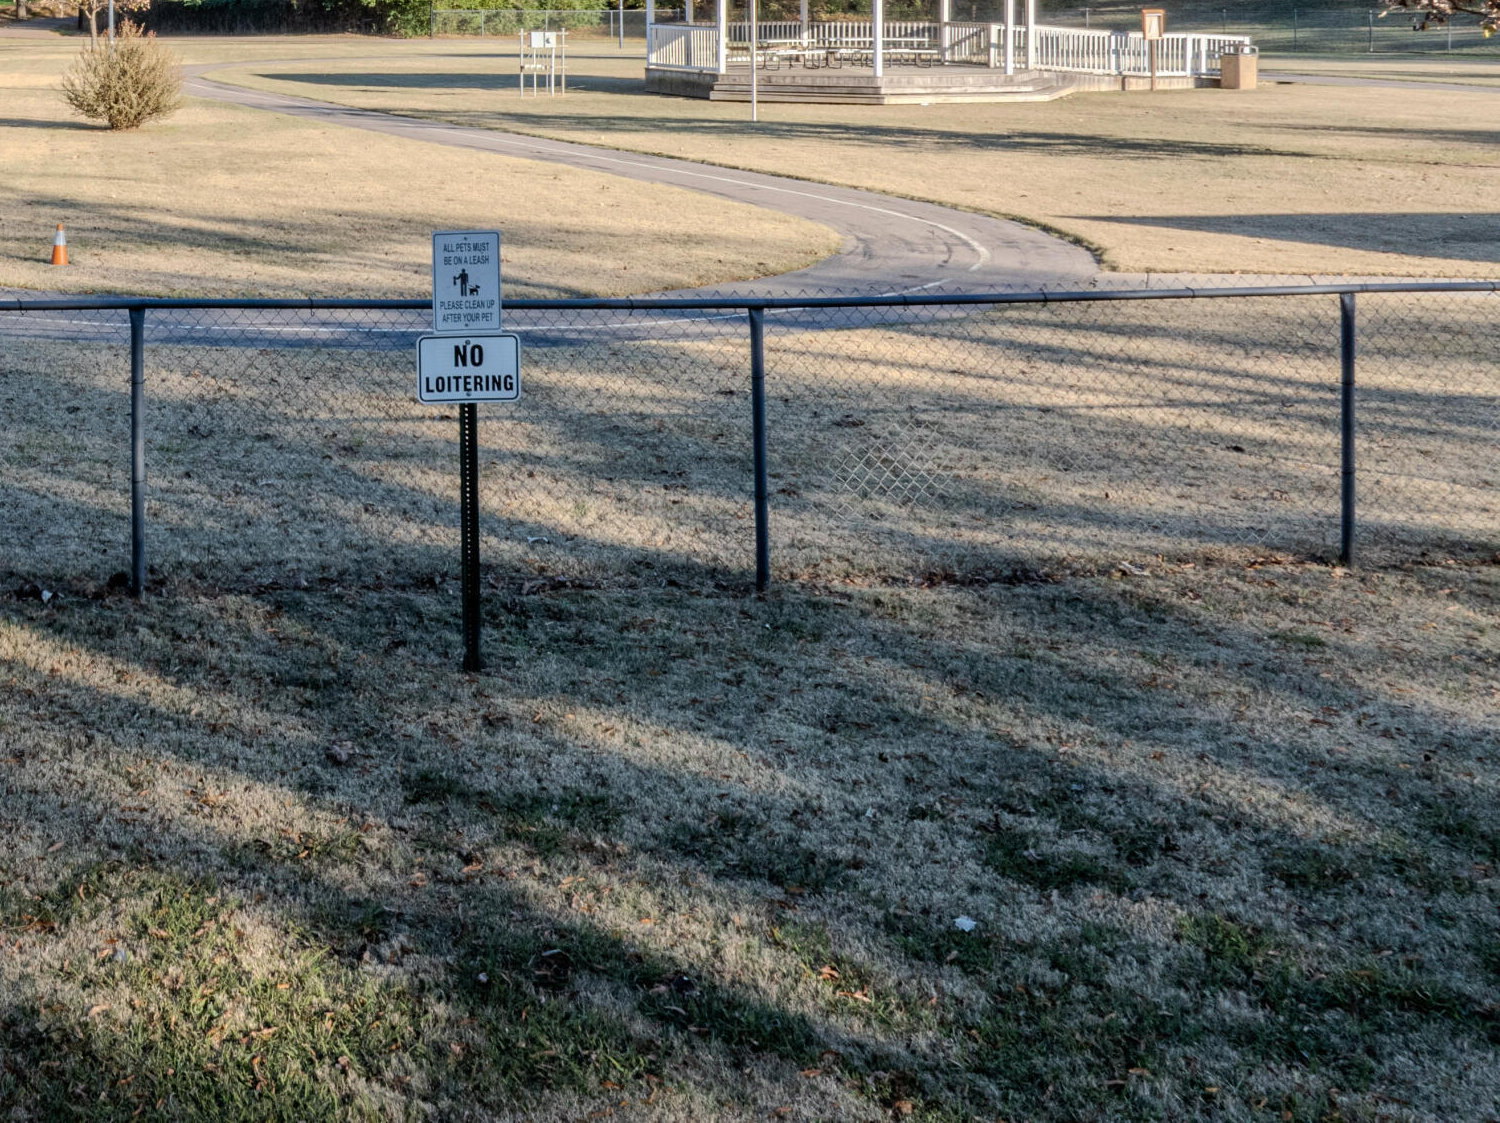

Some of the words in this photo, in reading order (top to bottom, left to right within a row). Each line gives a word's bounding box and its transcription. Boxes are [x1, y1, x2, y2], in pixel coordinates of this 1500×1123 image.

[443, 243, 454, 252] ALL
[456, 243, 471, 252] PETS
[473, 242, 489, 252] MUST
[443, 256, 452, 265] BE
[453, 256, 463, 265] ON
[464, 256, 469, 265] A
[469, 255, 489, 265] LEASH
[440, 300, 463, 310] PLEASE
[465, 300, 485, 309] CLEAN
[487, 299, 495, 309] UP
[442, 313, 462, 322] AFTER
[462, 312, 480, 322] YOUR
[482, 312, 493, 322] PET
[454, 344, 483, 367] NO
[426, 375, 513, 393] LOITERING
